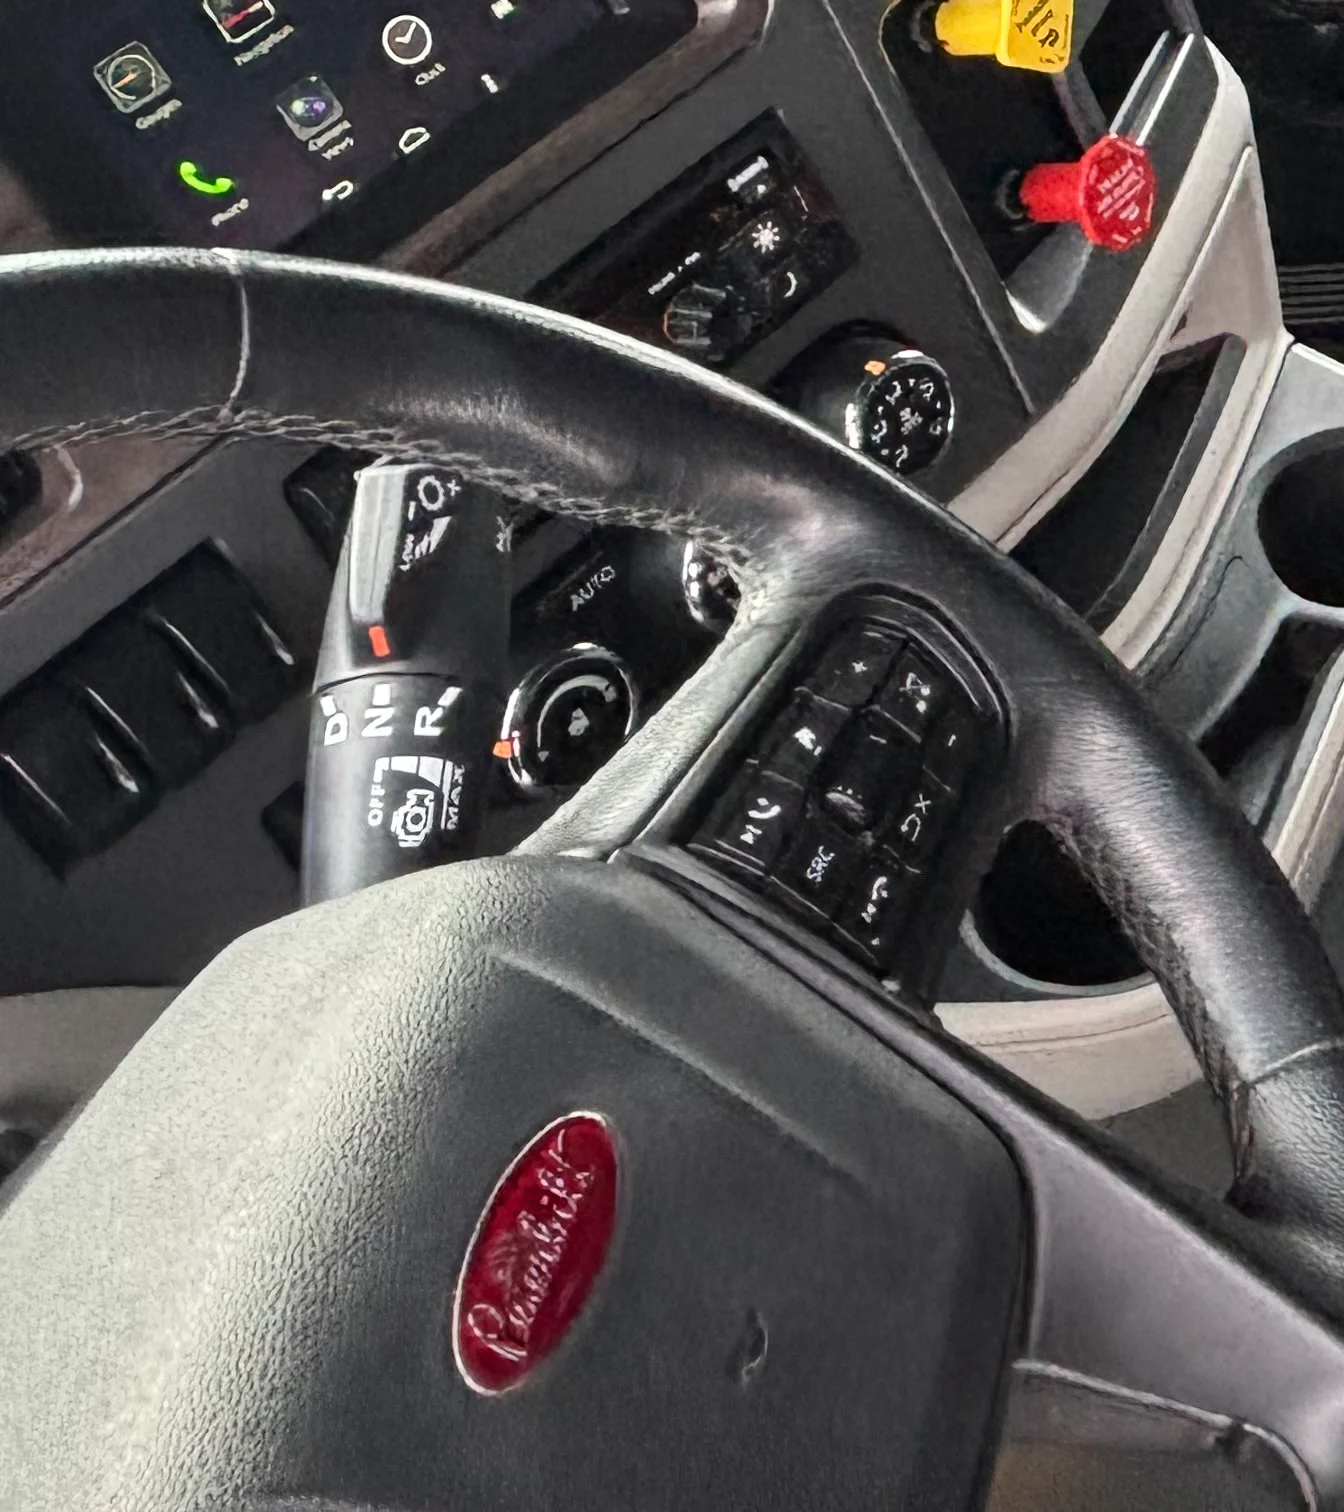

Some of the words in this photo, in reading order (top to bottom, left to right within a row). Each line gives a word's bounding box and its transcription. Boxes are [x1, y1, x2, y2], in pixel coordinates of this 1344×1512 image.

[569, 565, 616, 612] AUTO
[323, 712, 349, 746] D
[361, 707, 396, 737] N
[413, 706, 446, 737] R
[367, 784, 386, 828] OFF
[446, 763, 466, 830] MAX
[806, 845, 836, 882] SRC
